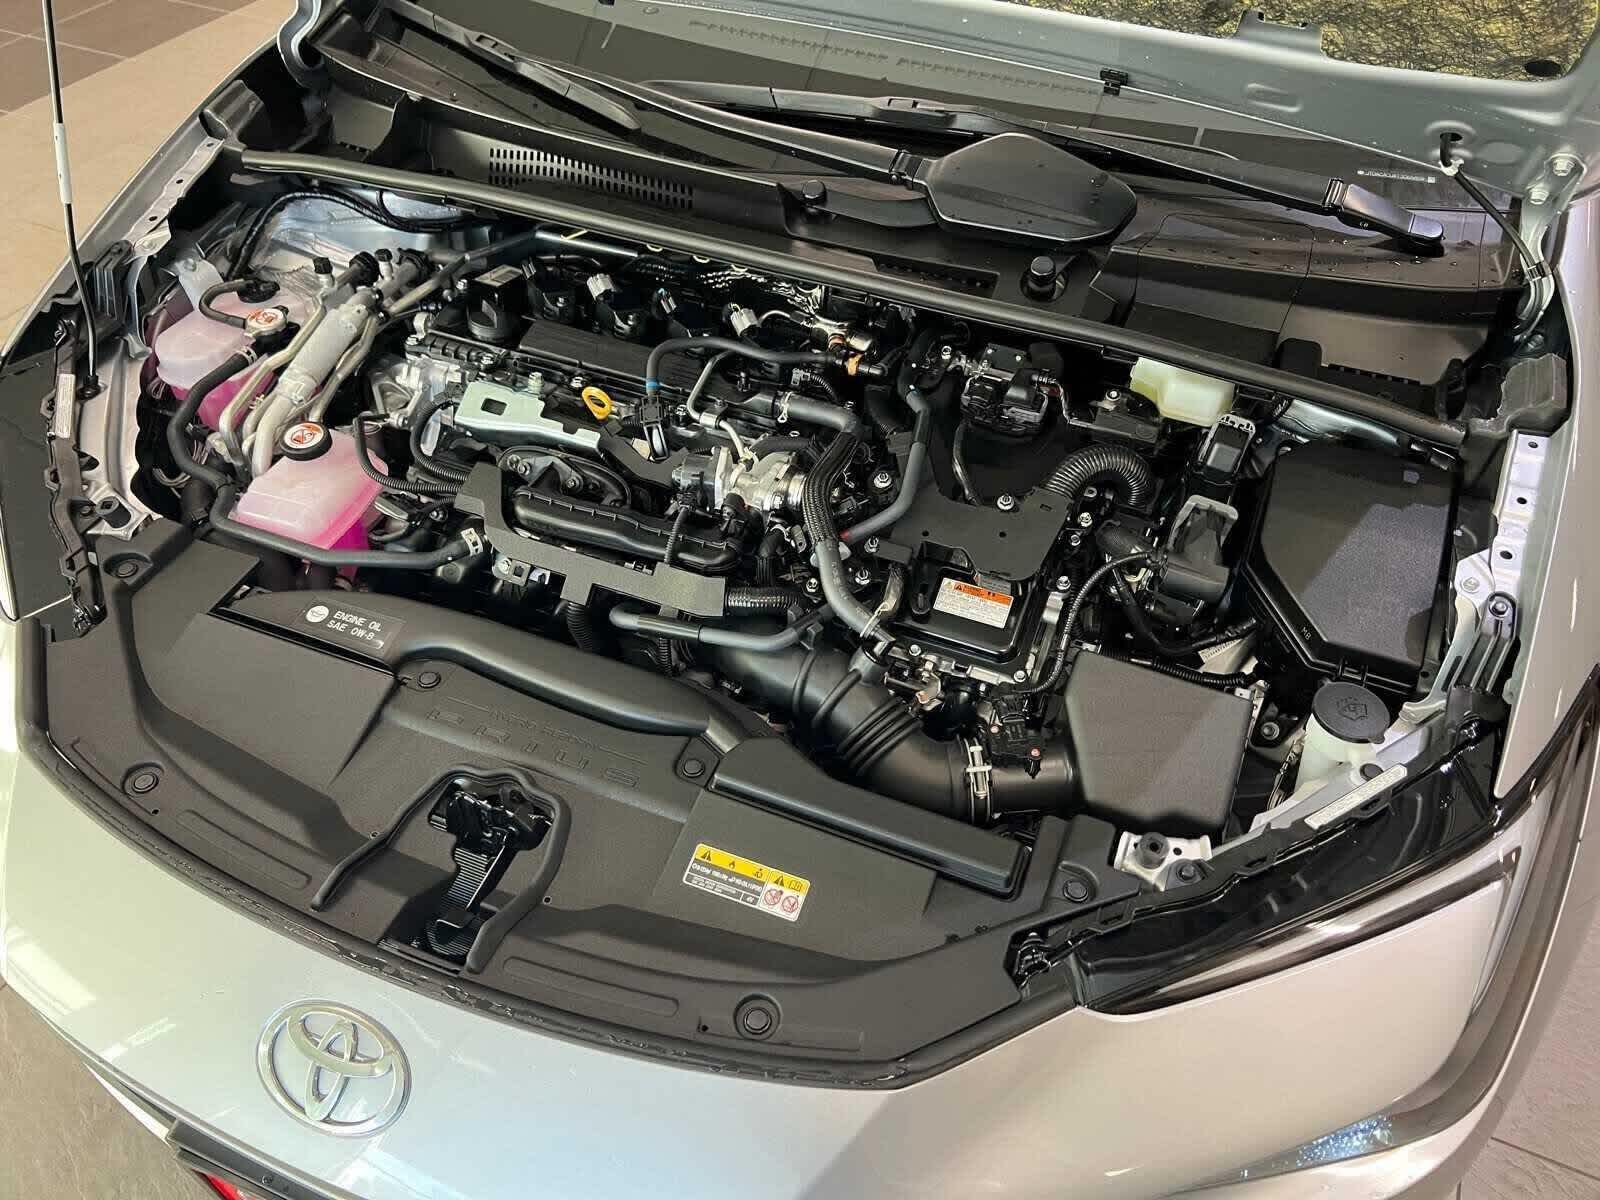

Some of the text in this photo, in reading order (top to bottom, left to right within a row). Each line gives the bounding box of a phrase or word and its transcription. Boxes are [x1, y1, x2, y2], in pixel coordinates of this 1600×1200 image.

[326, 619, 349, 632] SAE
[333, 610, 382, 632] ENGINE OIL
